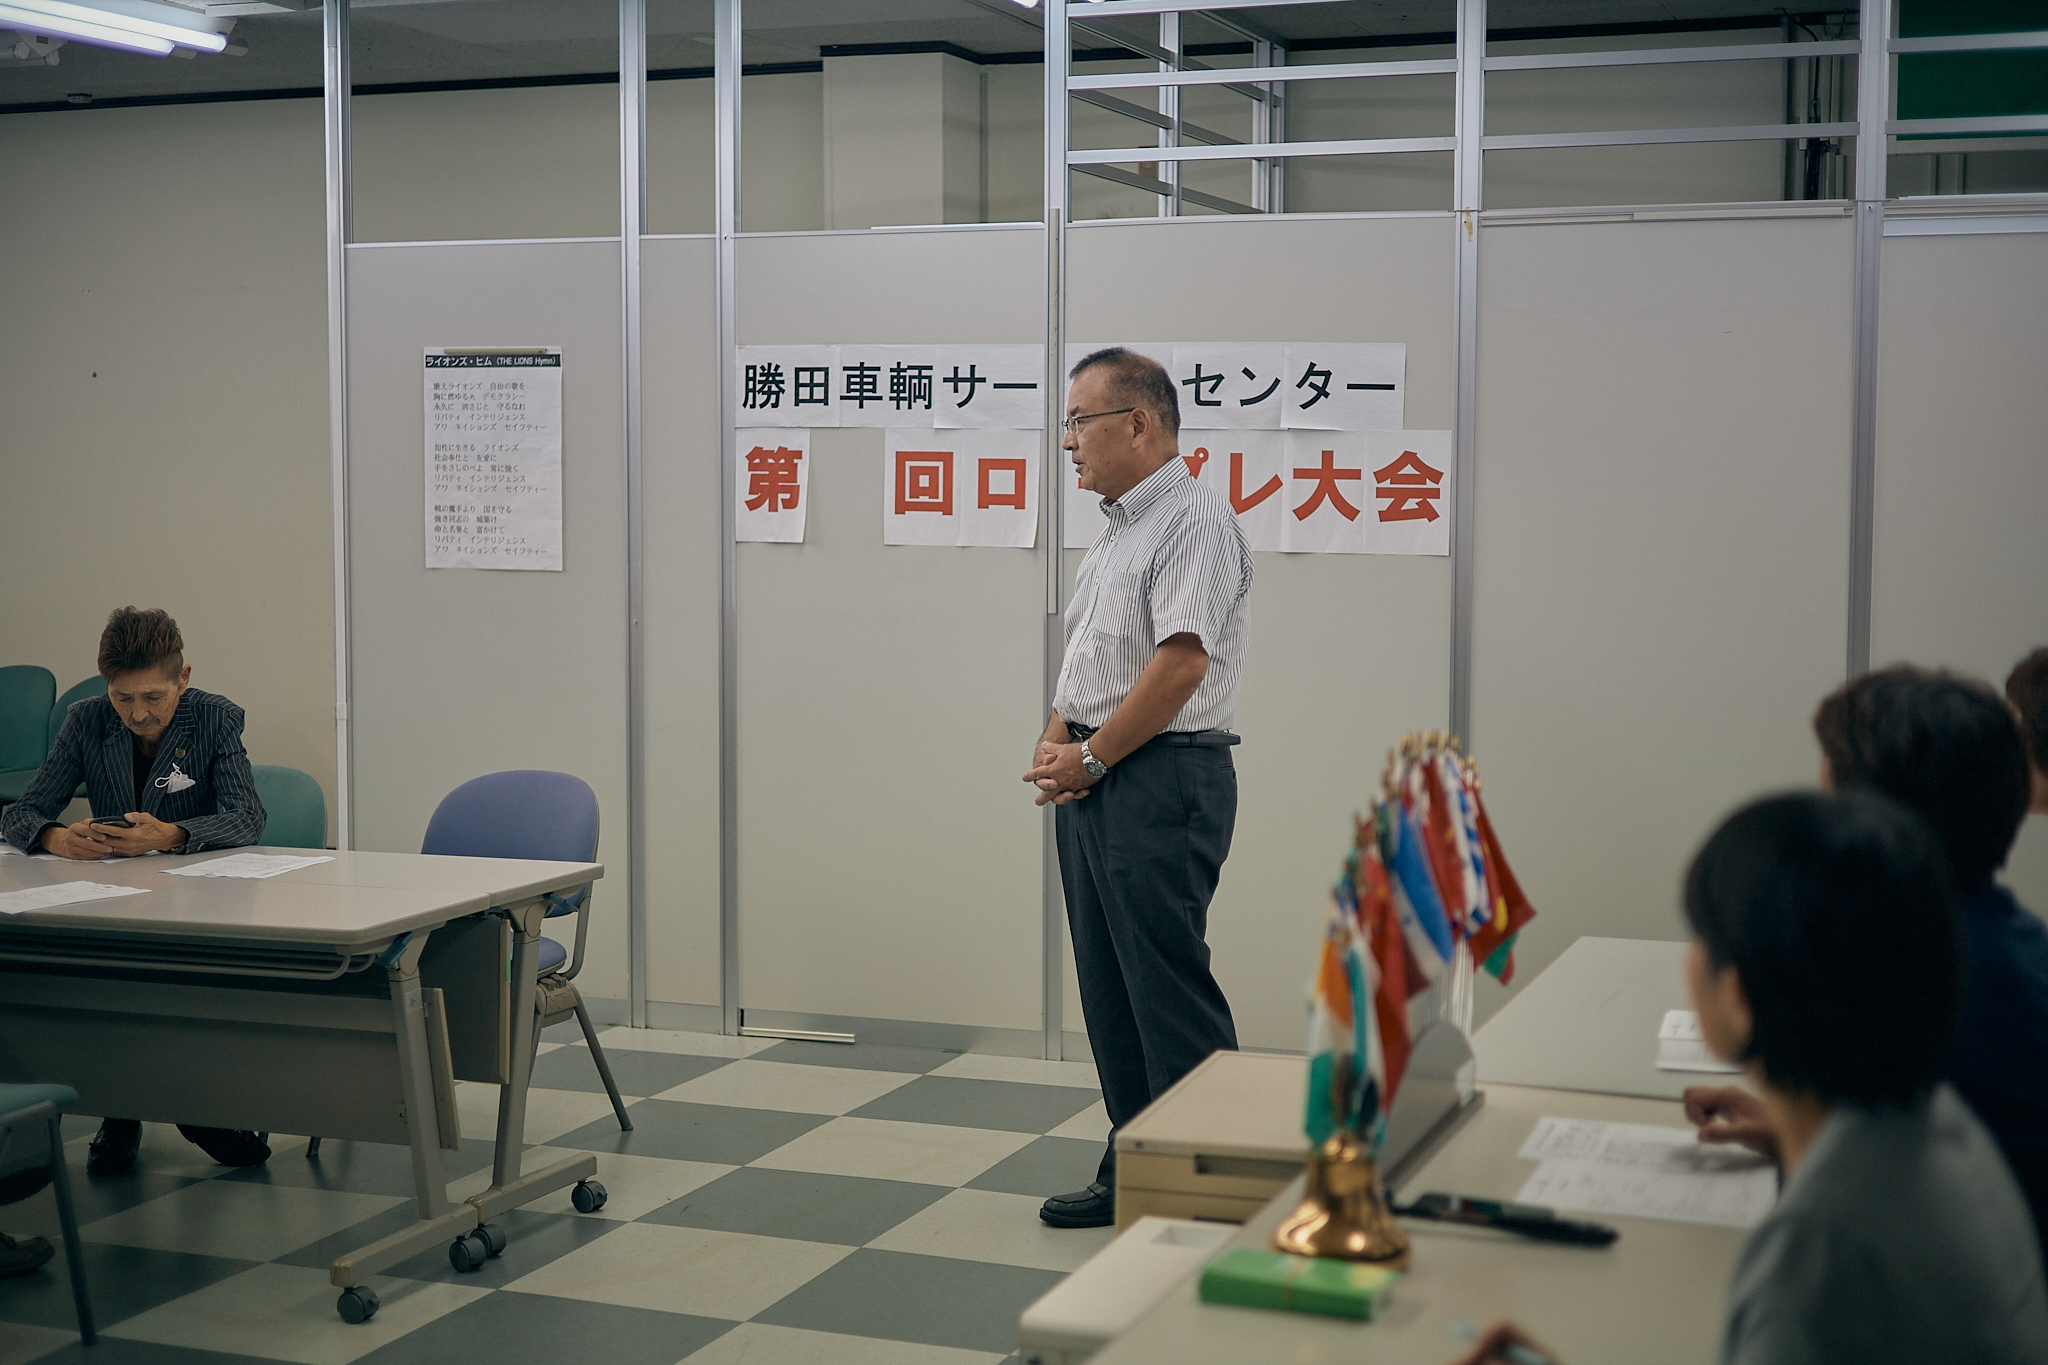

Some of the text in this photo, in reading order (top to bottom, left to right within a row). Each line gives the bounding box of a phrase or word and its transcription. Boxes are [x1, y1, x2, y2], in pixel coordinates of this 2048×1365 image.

[426, 356, 493, 367] ライオンズ・ヒム
[514, 356, 533, 365] LIONS
[433, 382, 525, 392] 歌えライオンズ 自由の歌を
[483, 392, 525, 401] デモクラシー
[433, 402, 454, 411] 永久に
[469, 412, 526, 421] インテリジェンス
[434, 423, 546, 432] アワ ネイションズ セイフティー
[434, 444, 519, 452] 知性に生きる ライオンズ
[434, 454, 497, 462] 社会奉仕と 友愛に
[490, 464, 518, 472] 常に強く
[469, 474, 526, 483] インテリジェンス
[745, 446, 803, 513] 第
[434, 484, 546, 493] アワ ネイションズ セイフティー
[484, 504, 512, 514] 国を守る
[469, 536, 526, 544] インテリジェンス
[434, 546, 547, 556] アワ ネイションズ セイフティー
